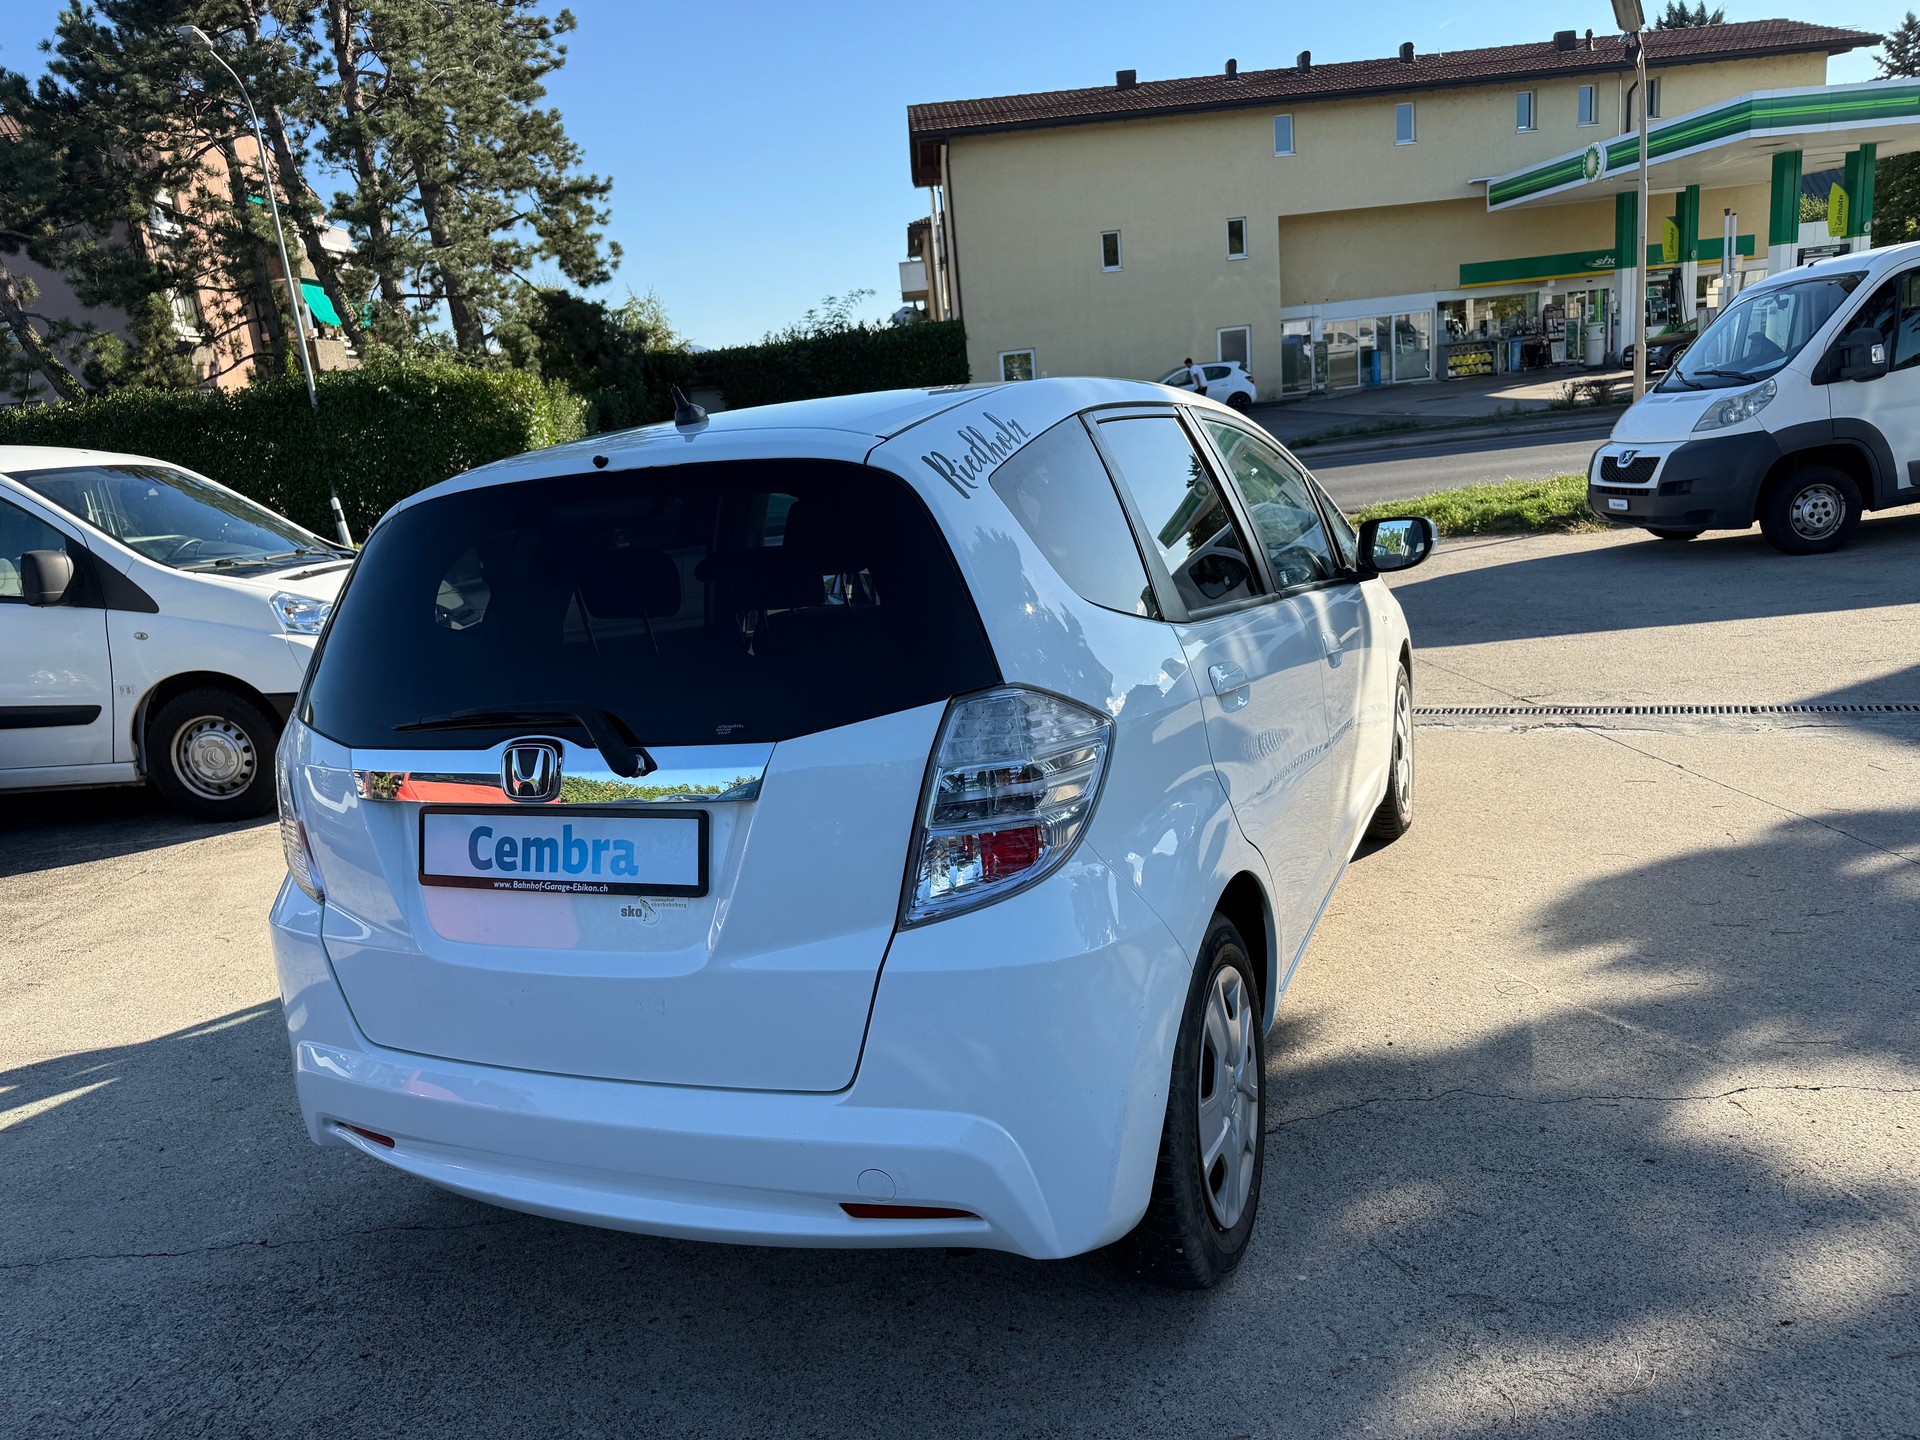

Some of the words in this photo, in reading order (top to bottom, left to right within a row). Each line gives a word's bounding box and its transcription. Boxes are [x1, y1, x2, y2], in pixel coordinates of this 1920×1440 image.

[921, 411, 1032, 499] Riedholz
[468, 823, 639, 877] Cembra
[493, 881, 511, 889] www.
[513, 881, 609, 892] Bahnhof-Garage-Ebikon.ch
[620, 905, 643, 918] sko
